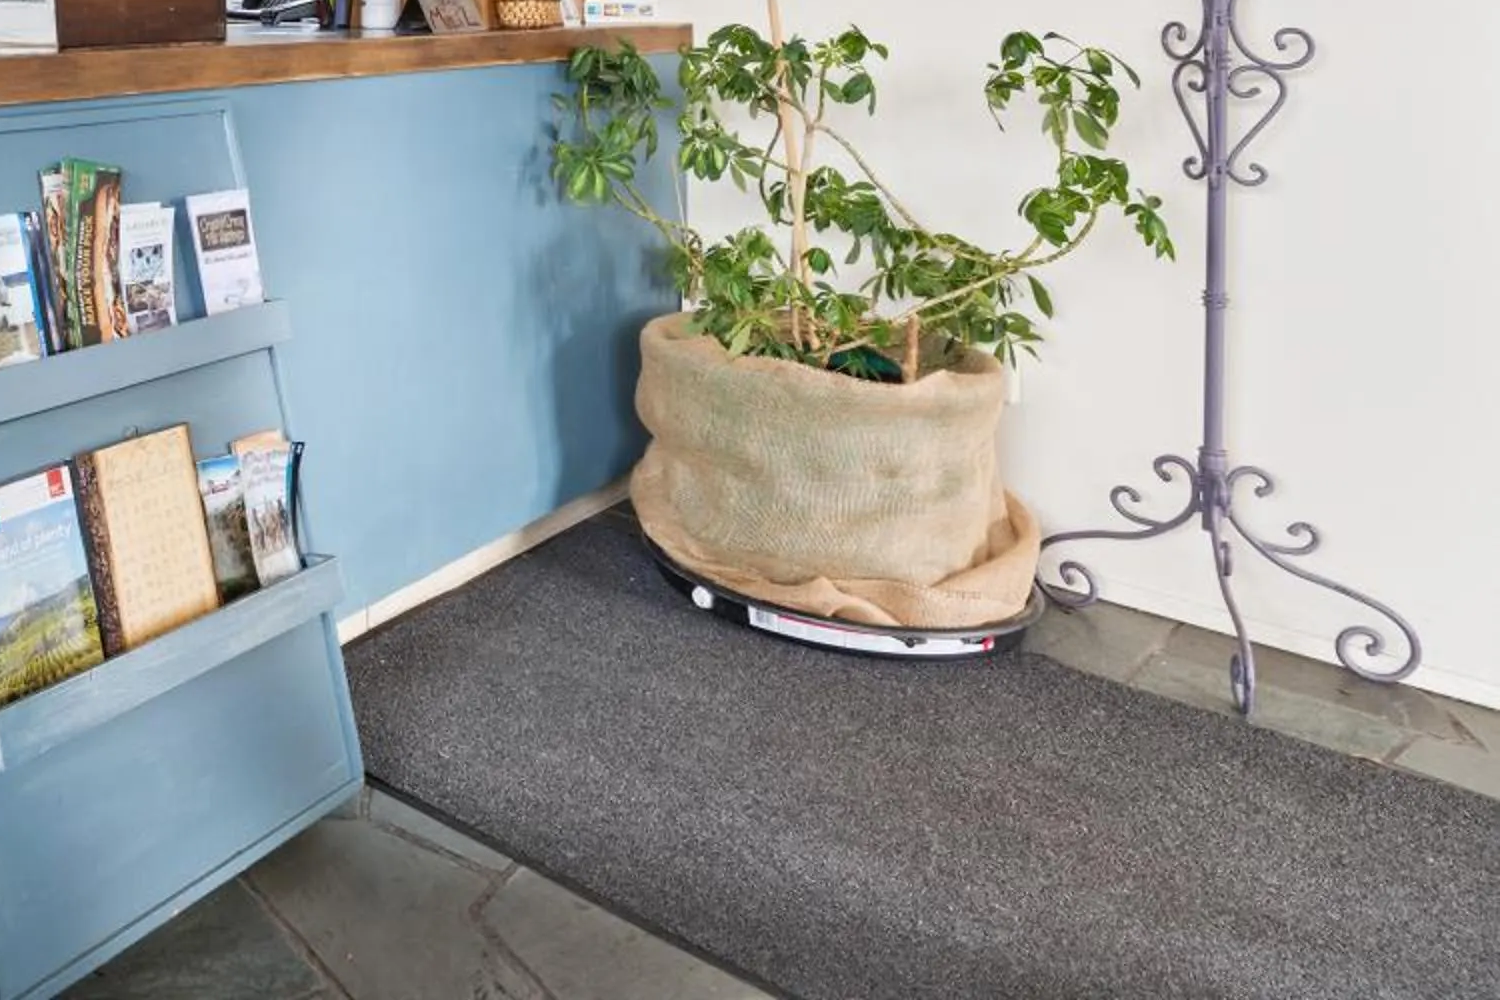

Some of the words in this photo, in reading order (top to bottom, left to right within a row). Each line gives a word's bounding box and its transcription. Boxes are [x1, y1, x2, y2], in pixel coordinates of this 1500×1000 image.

[84, 215, 93, 247] PICK
[82, 249, 92, 284] YOUR
[83, 289, 95, 326] MAKE
